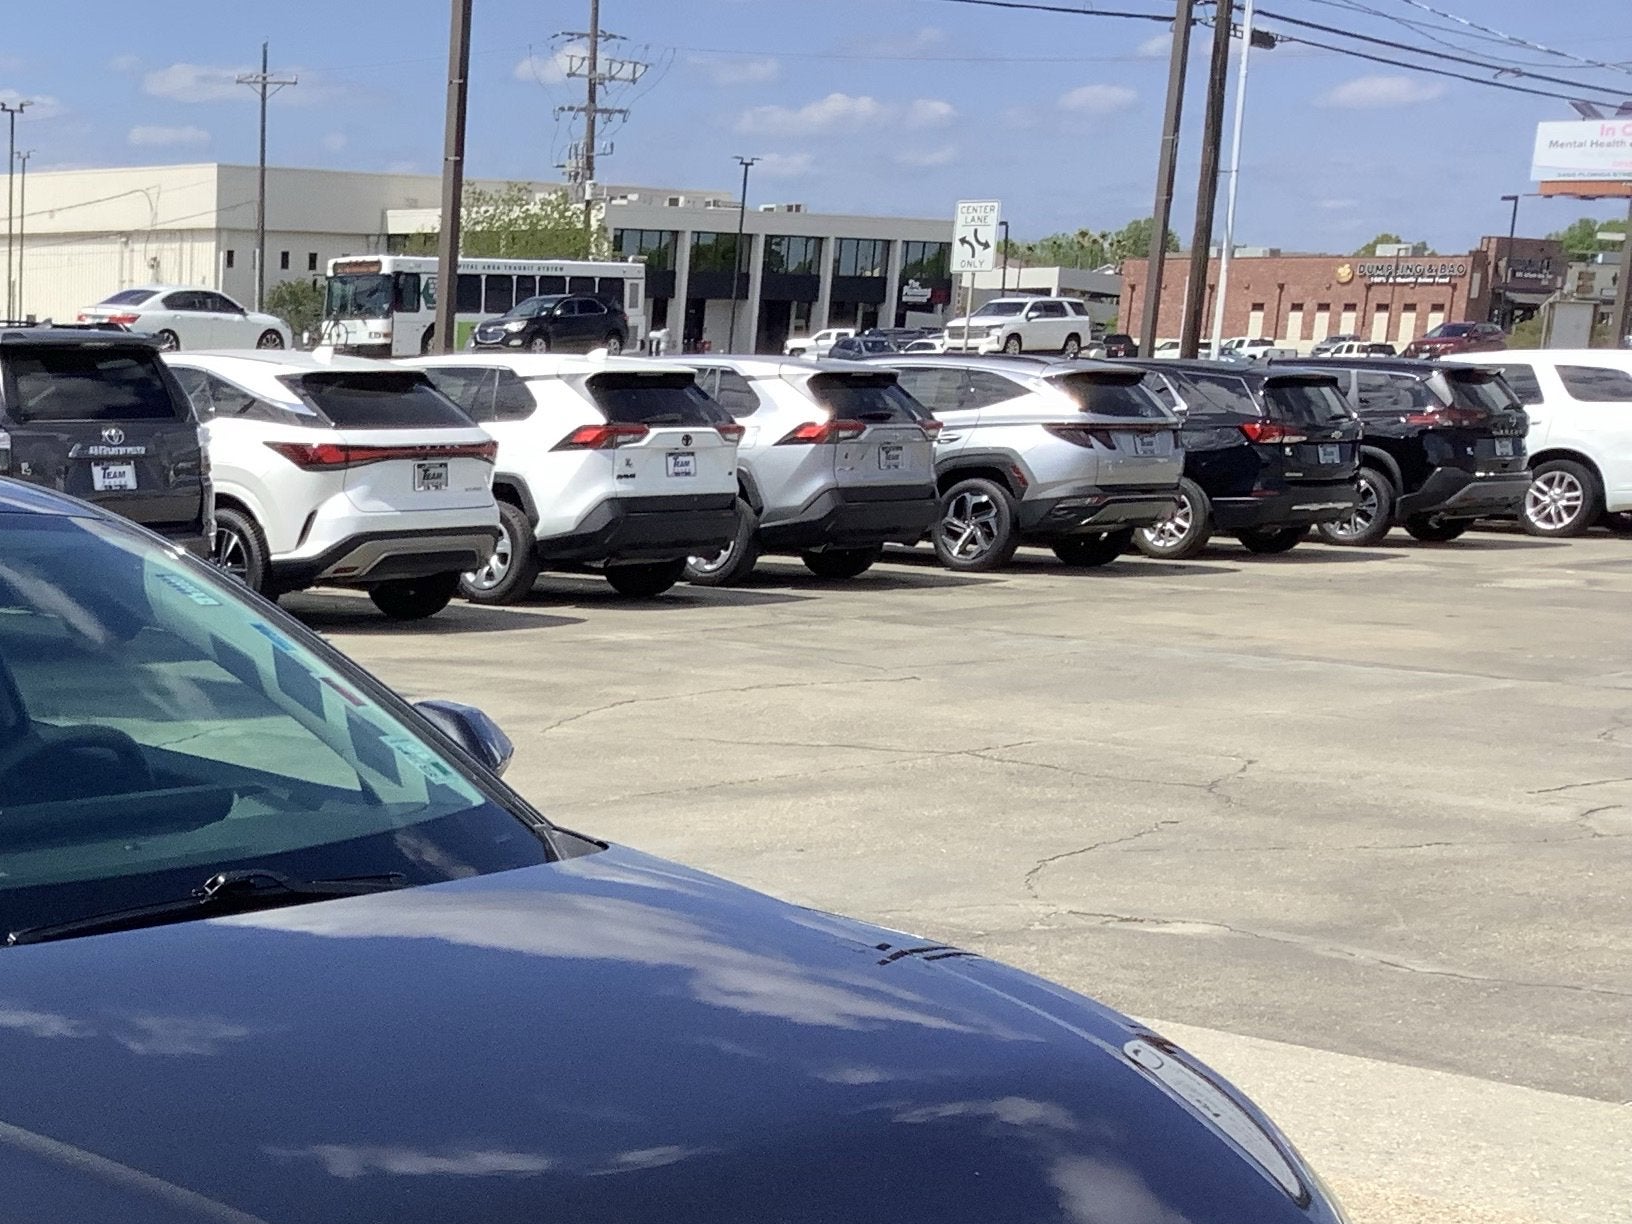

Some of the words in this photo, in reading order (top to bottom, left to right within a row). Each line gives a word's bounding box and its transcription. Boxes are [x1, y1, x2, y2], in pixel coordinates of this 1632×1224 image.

[1549, 140, 1587, 149] Mental
[1590, 140, 1626, 149] Health
[960, 205, 995, 215] CENTER
[965, 215, 989, 224] LANE
[960, 259, 985, 268] ONLY
[1438, 264, 1467, 276] BAO
[101, 465, 126, 479] TEAM
